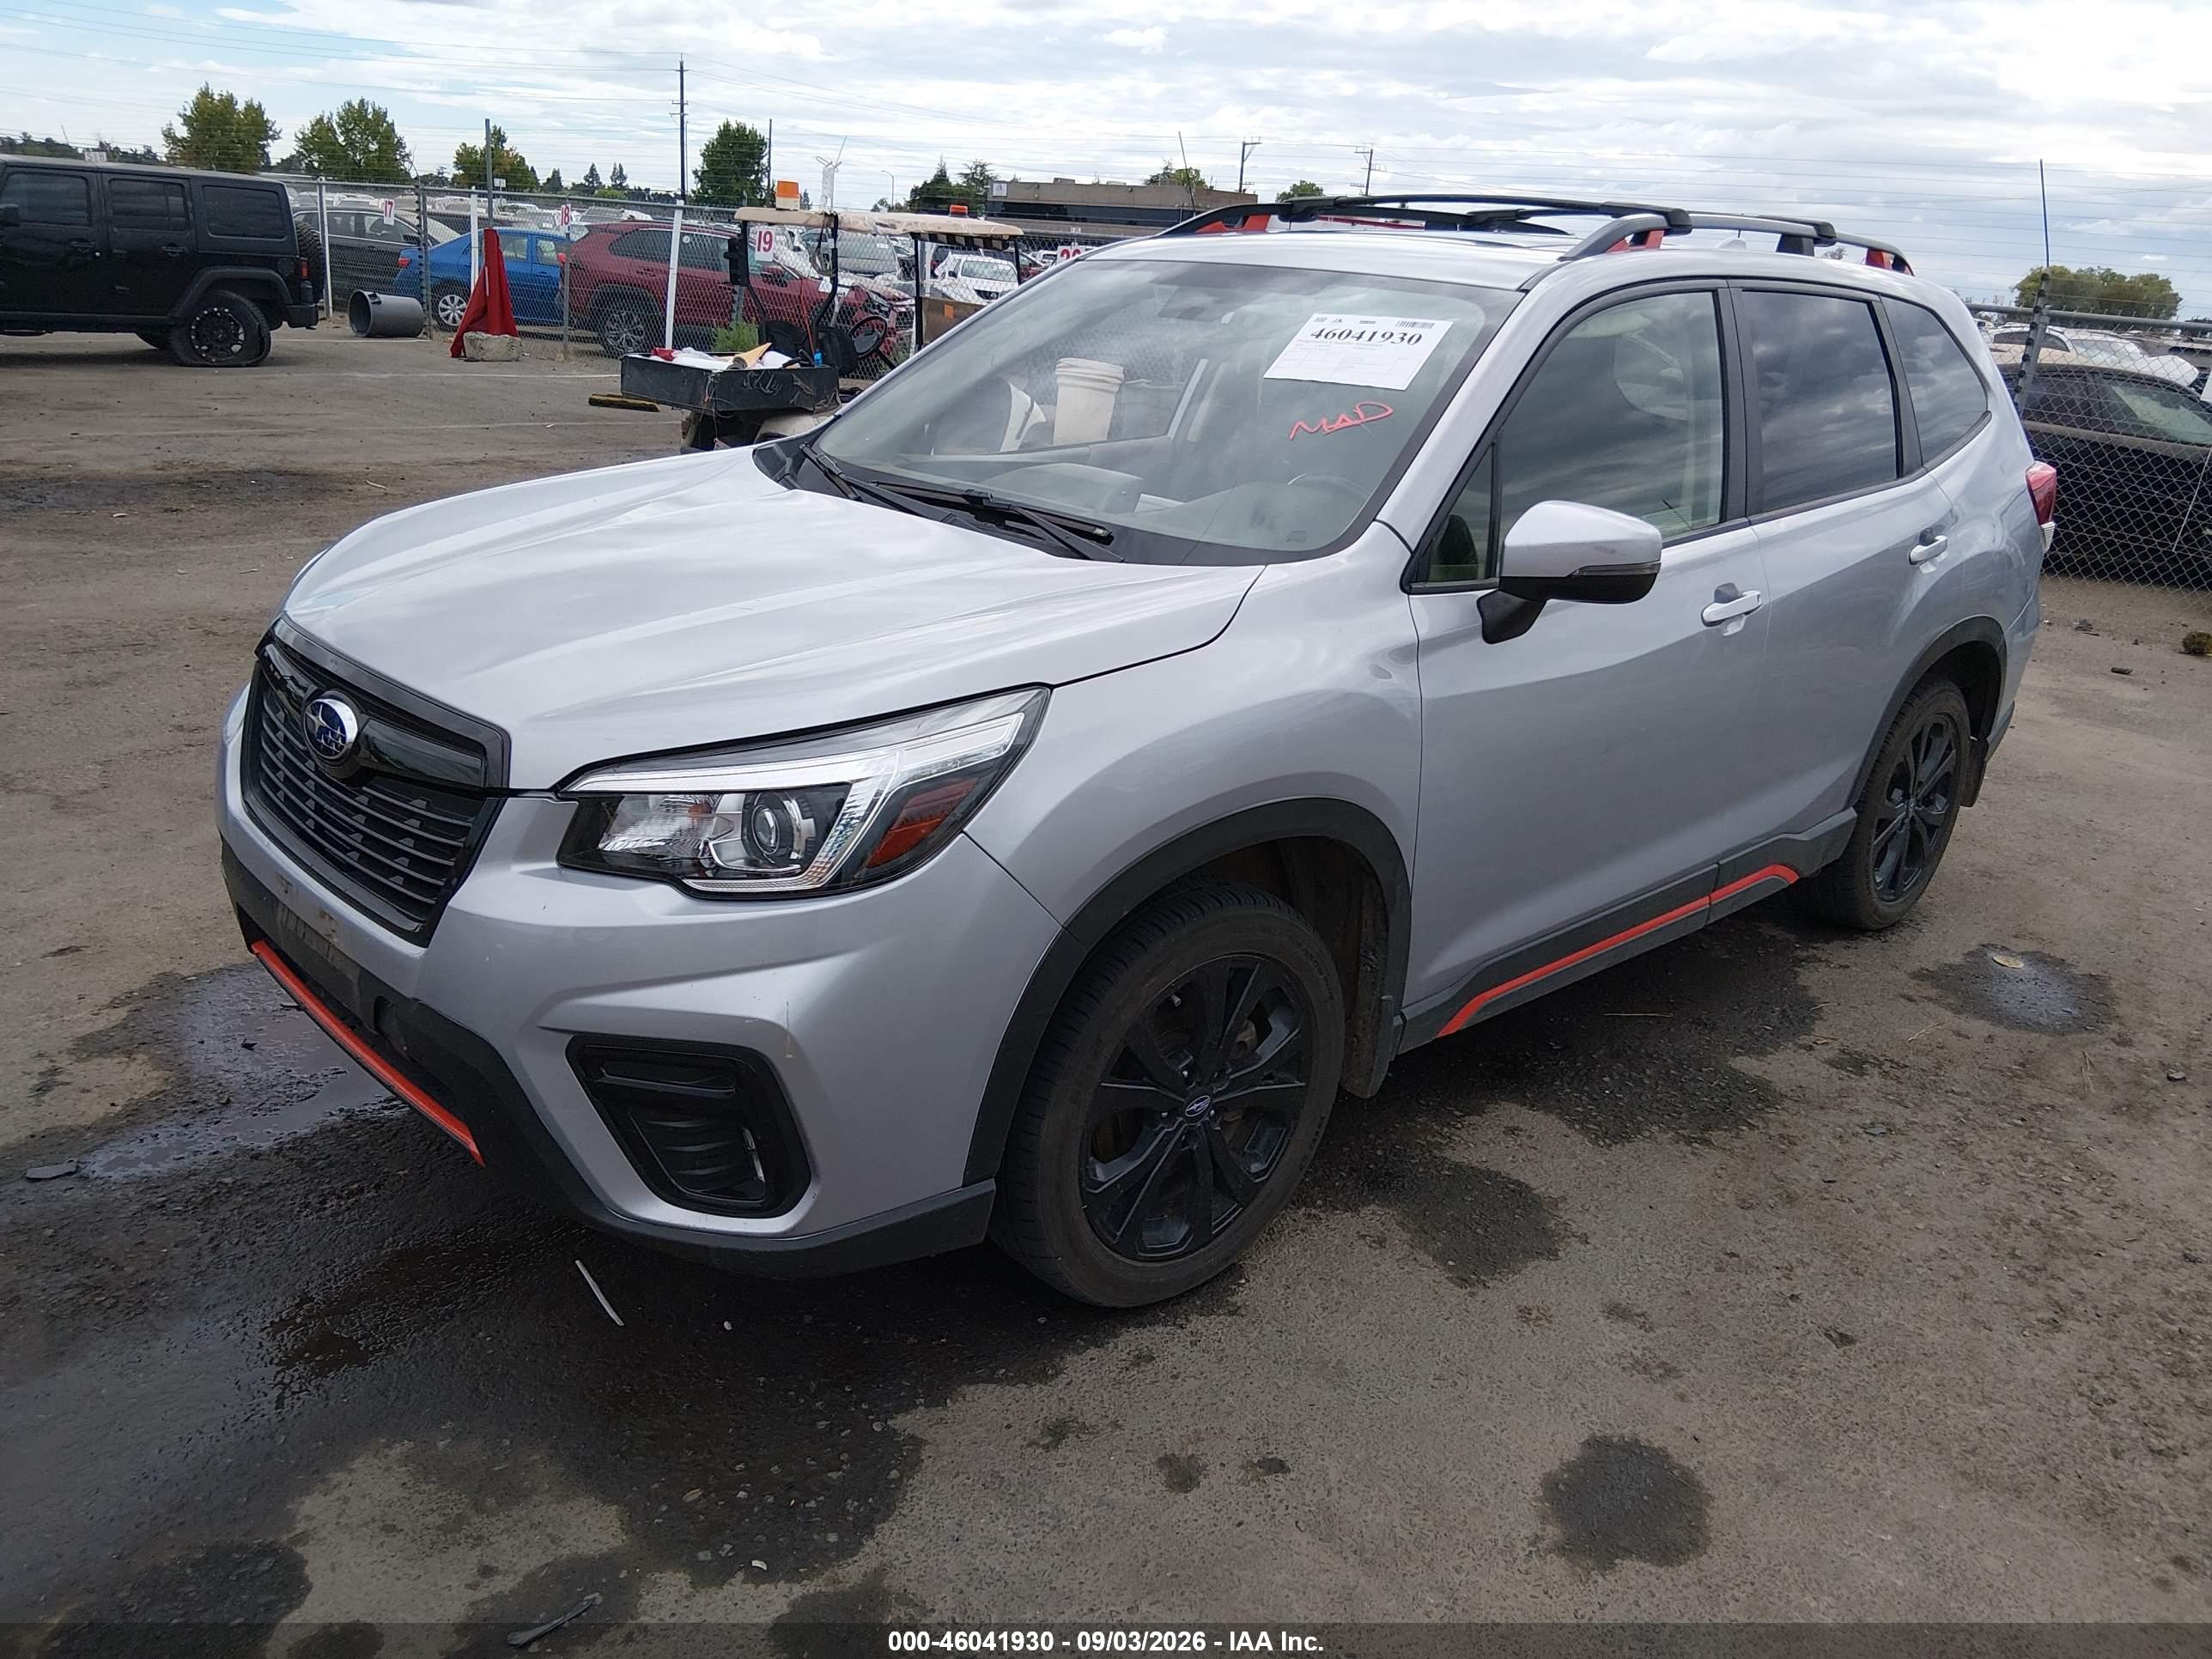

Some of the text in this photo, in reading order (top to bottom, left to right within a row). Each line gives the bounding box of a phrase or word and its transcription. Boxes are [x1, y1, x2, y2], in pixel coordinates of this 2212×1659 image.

[385, 199, 393, 218] 17
[561, 205, 570, 227] 18
[757, 230, 773, 253] 19
[1310, 327, 1423, 346] 46041930
